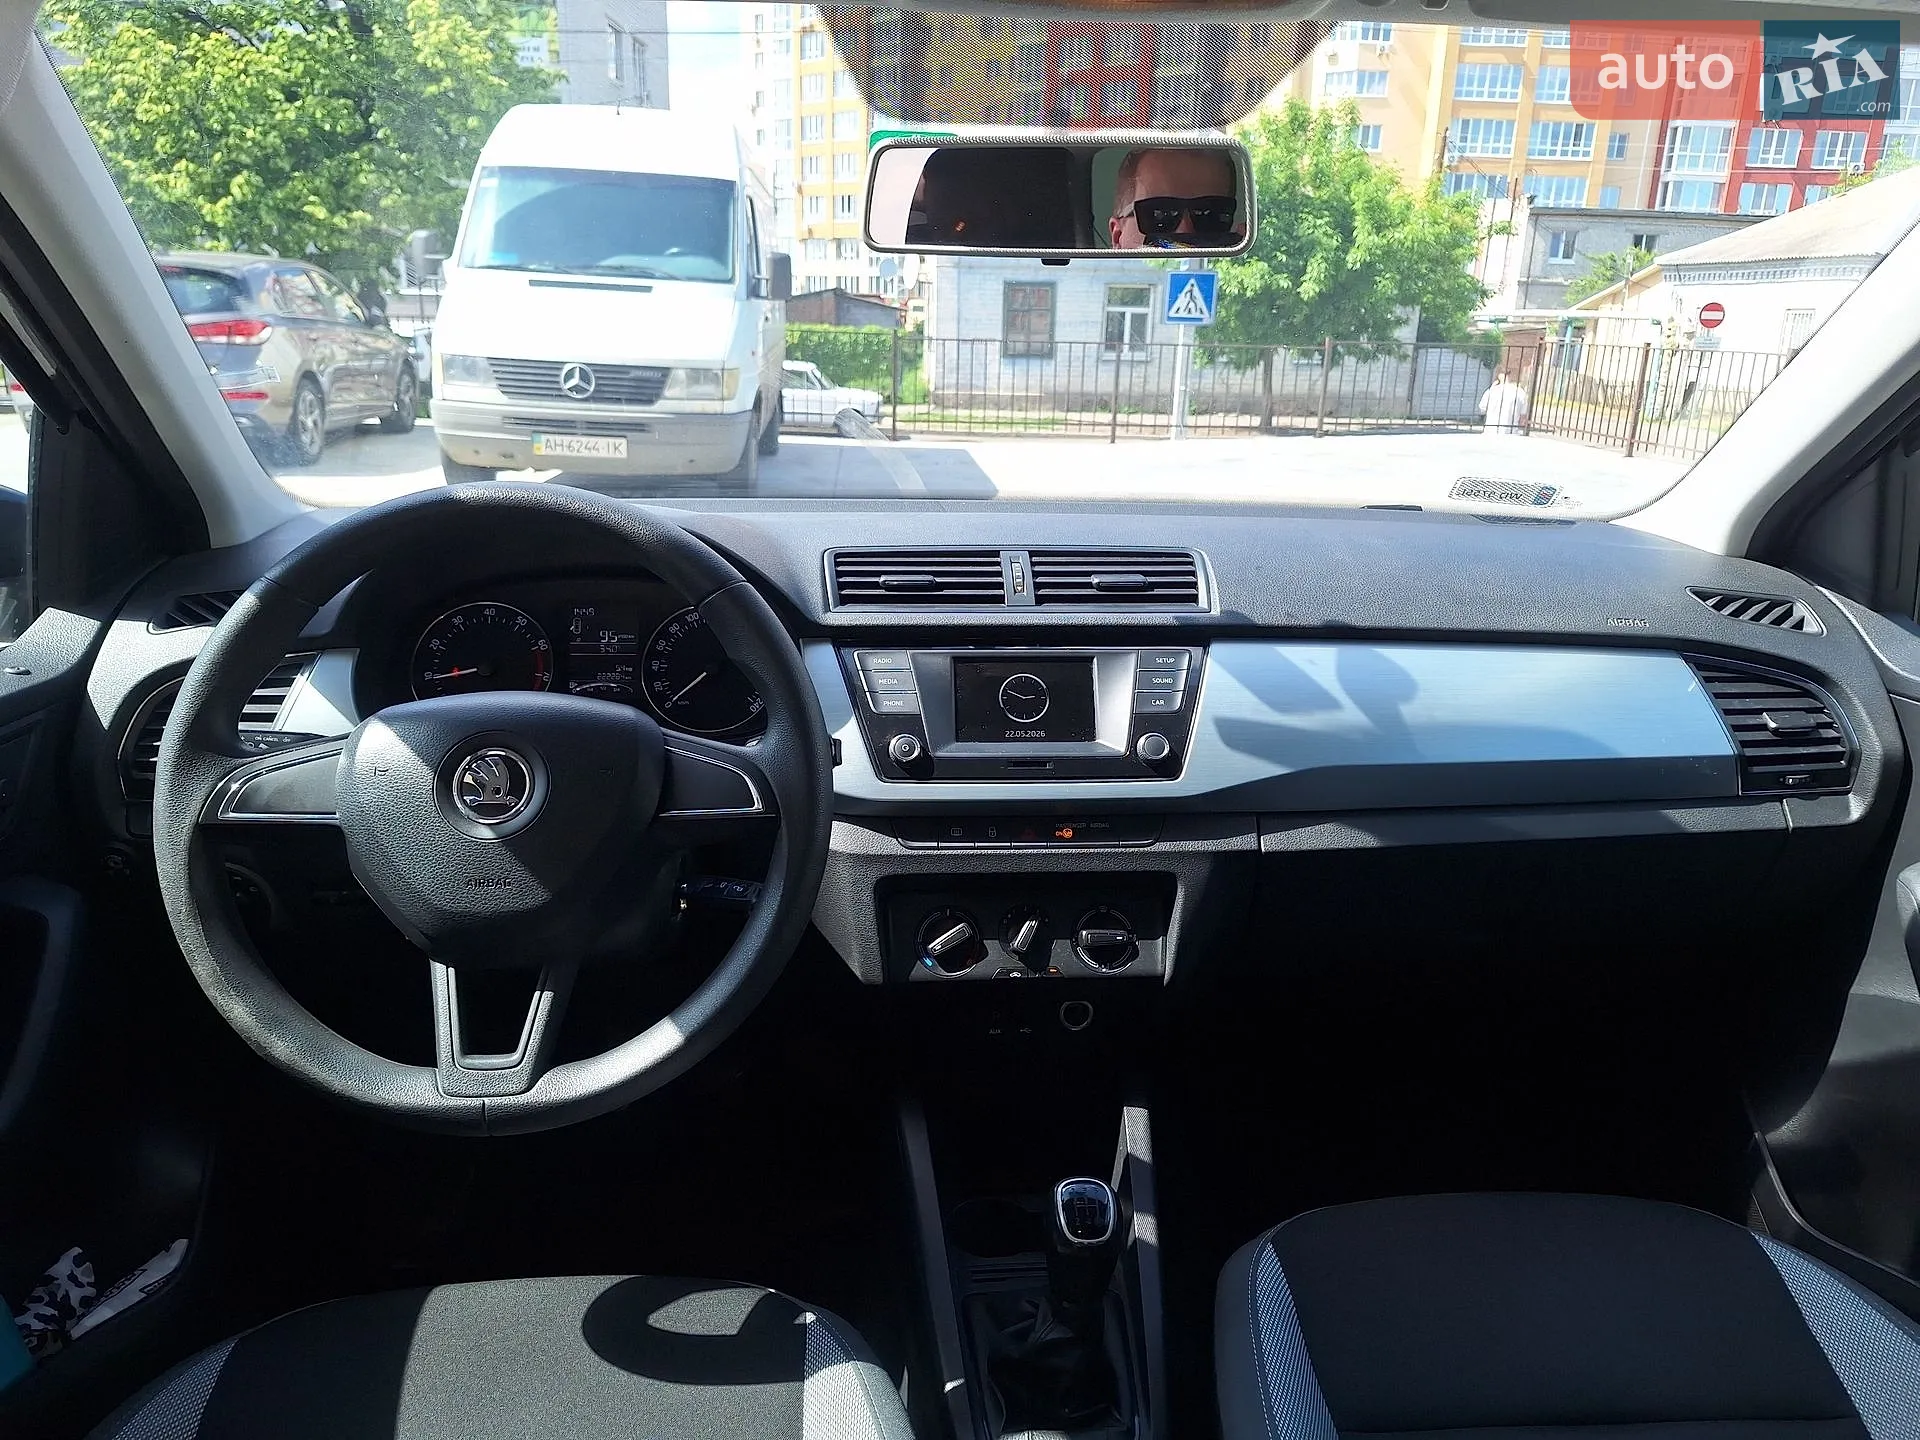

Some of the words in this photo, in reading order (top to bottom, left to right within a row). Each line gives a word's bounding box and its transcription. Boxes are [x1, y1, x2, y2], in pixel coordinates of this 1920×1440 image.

[483, 607, 496, 616] 40
[684, 611, 700, 622] 100
[451, 615, 464, 627] 30
[515, 615, 528, 626] 50
[1607, 617, 1650, 628] AIRBAG
[668, 622, 680, 634] 80
[428, 638, 440, 650] 20
[537, 639, 549, 650] 60
[655, 639, 666, 651] 60
[651, 660, 660, 672] 40
[423, 671, 433, 681] 10
[653, 681, 663, 692] 20
[664, 701, 673, 709] 0
[749, 697, 765, 713] 240
[1004, 730, 1046, 738] 22.05.2026
[466, 878, 512, 890] AIRBAG
